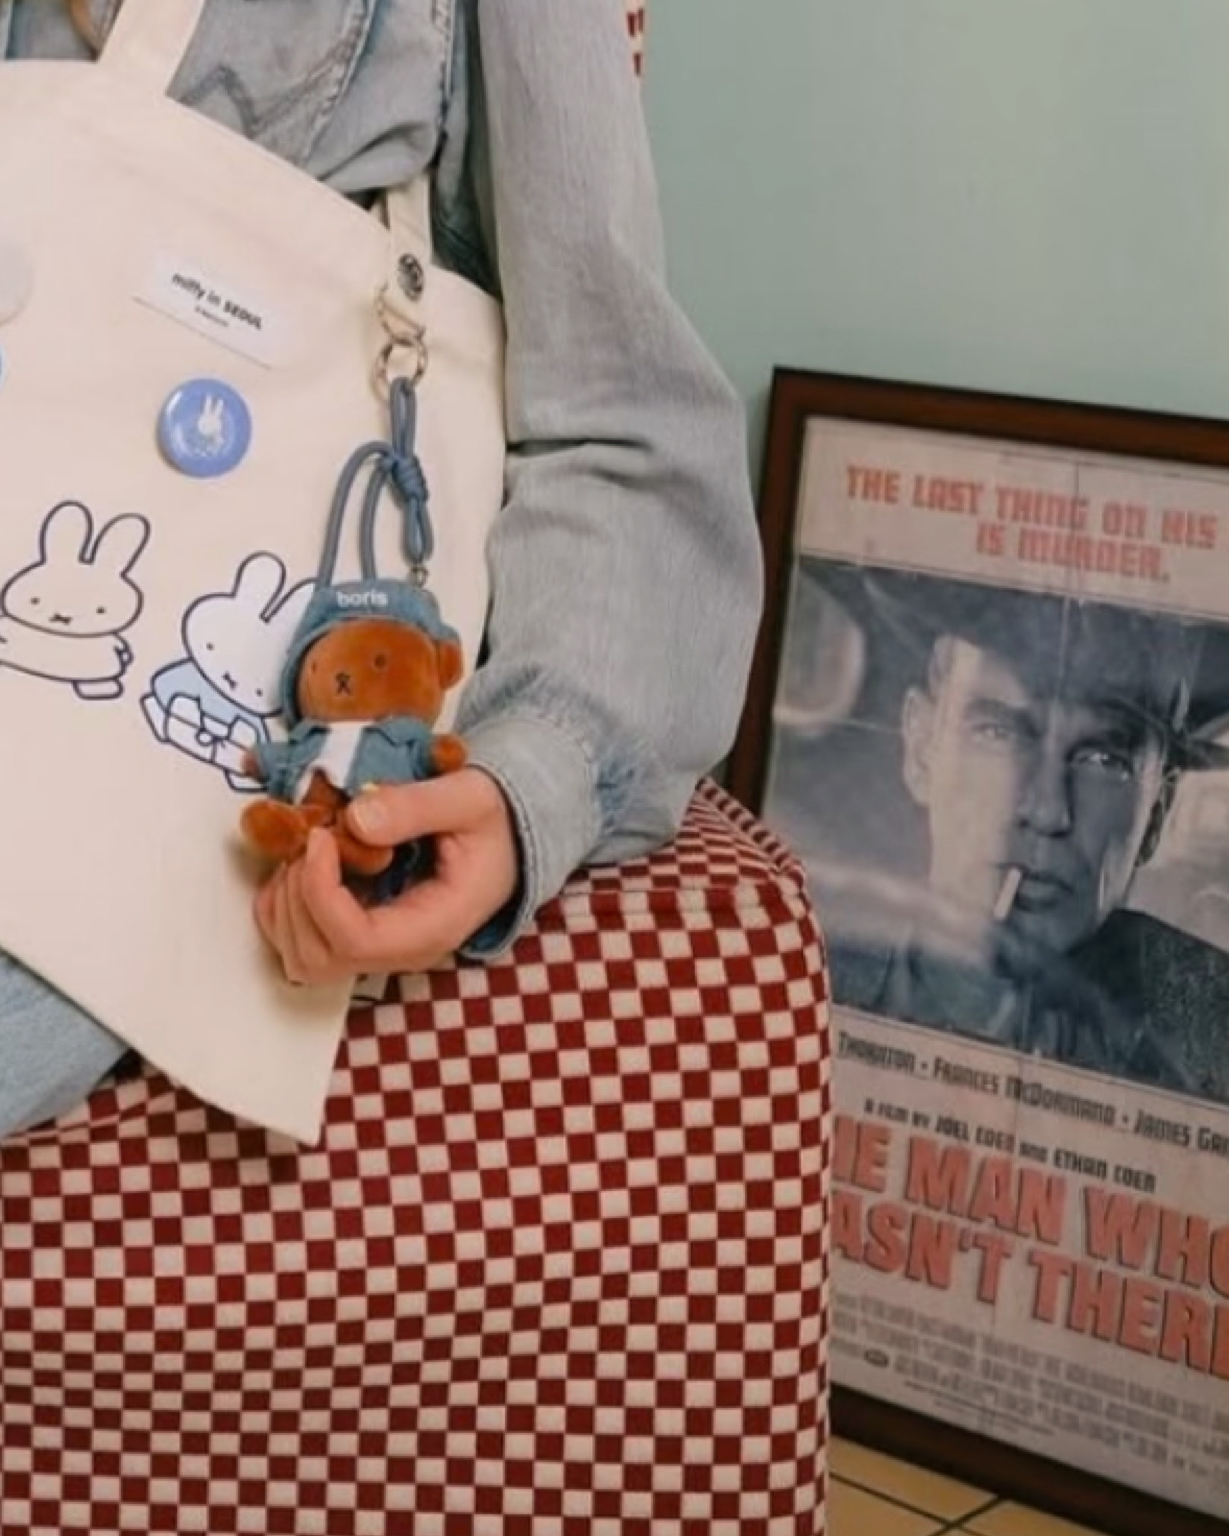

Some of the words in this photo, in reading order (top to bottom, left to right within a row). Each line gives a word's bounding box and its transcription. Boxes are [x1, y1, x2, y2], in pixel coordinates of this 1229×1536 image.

[207, 290, 221, 307] in
[223, 300, 262, 331] SEOUL
[847, 466, 900, 505] THE
[912, 475, 984, 515] LAST
[995, 486, 1089, 531] THING
[1102, 501, 1147, 540] ON
[1160, 508, 1218, 550] HIS
[977, 523, 1005, 556] IS
[1018, 528, 1169, 582] MURDER.
[336, 588, 389, 608] boris
[934, 1056, 999, 1096] FRANCES
[1134, 1109, 1190, 1148] JAMES
[904, 1134, 1067, 1246] MAN
[935, 1115, 969, 1142] JOEL
[976, 1125, 1015, 1154] COEN
[1054, 1147, 1109, 1181] ETHAN
[1114, 1163, 1157, 1194] COEN
[831, 1187, 1013, 1306] ASN'T
